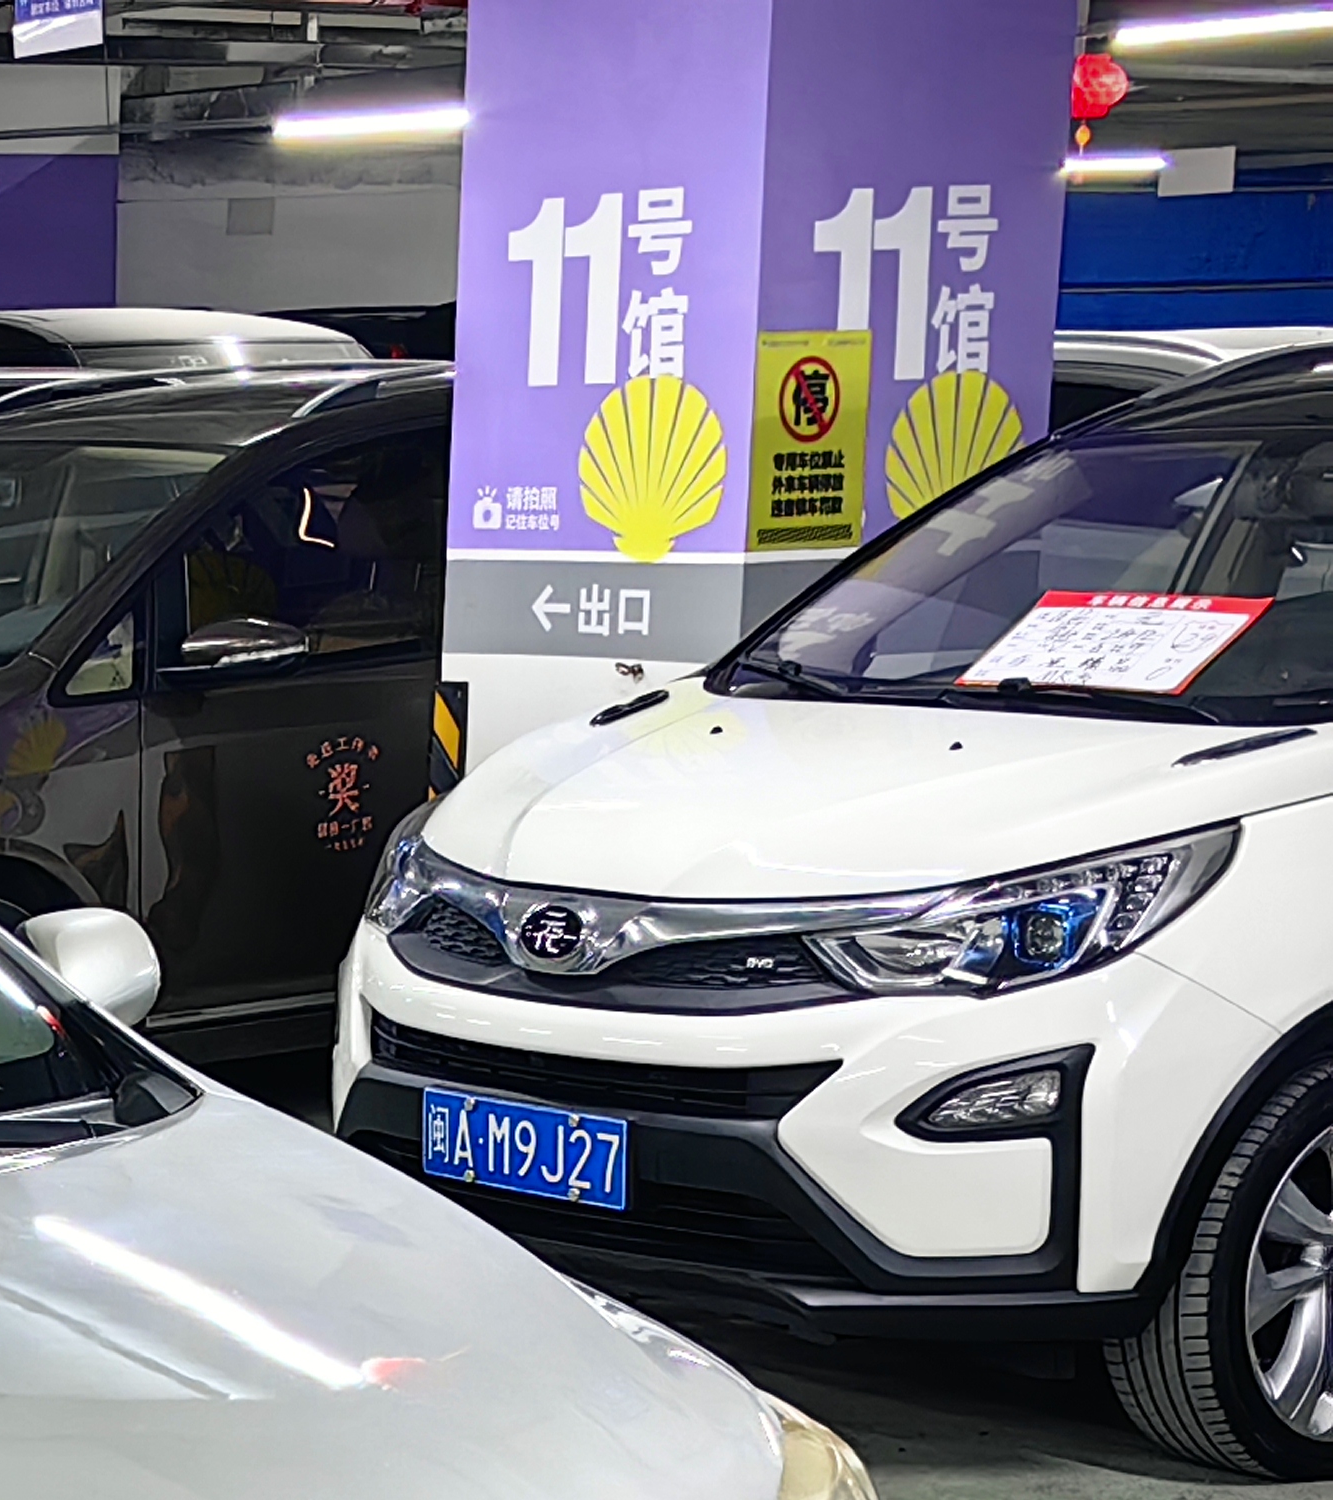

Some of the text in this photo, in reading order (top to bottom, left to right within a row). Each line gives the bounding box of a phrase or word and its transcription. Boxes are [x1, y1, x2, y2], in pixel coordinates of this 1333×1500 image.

[508, 192, 623, 387] 11
[506, 486, 558, 512] 请拍照
[505, 513, 560, 531] 记住车位号
[577, 583, 651, 637] 出口
